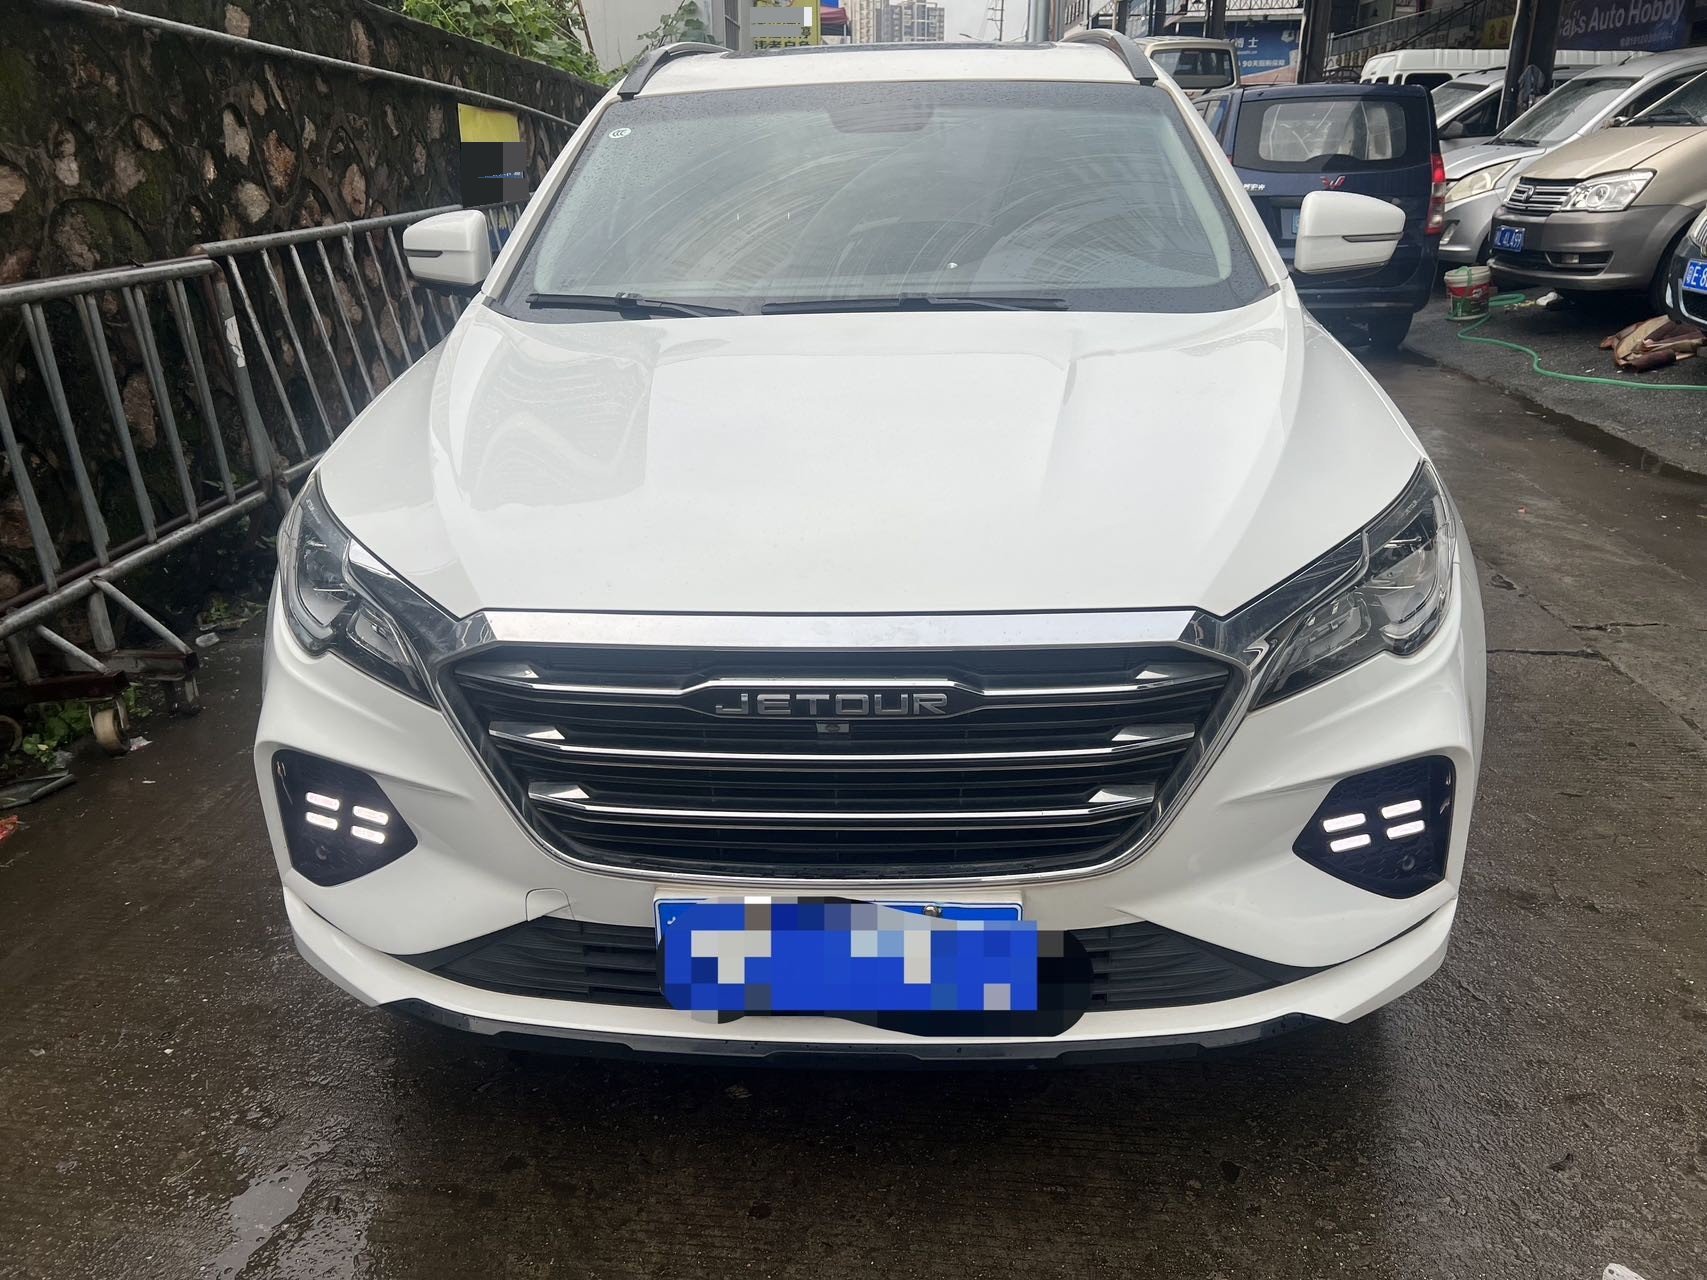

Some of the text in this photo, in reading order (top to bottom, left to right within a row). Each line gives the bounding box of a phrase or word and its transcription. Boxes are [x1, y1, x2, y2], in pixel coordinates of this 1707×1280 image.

[1588, 4, 1625, 32] Auto
[1628, 0, 1686, 25] Hobby
[715, 693, 948, 715] JETOUR
